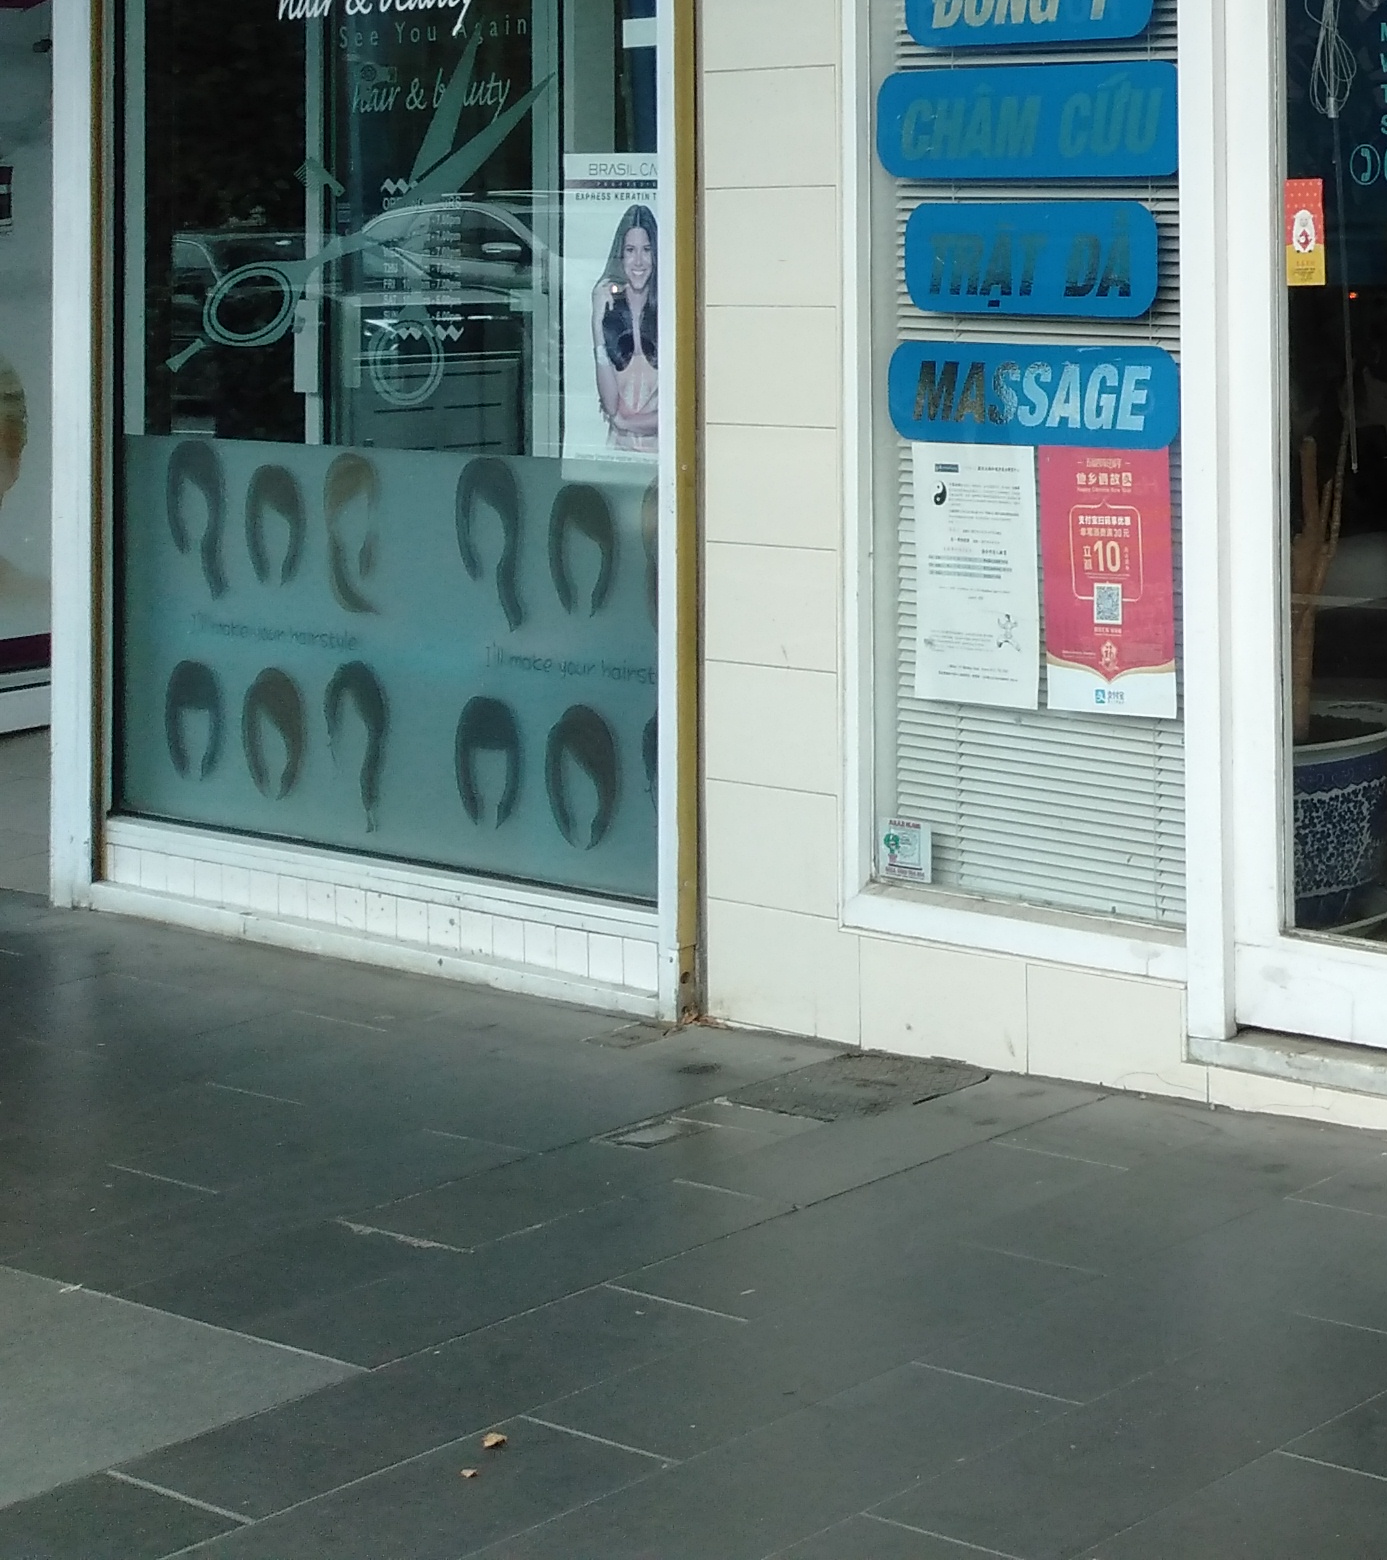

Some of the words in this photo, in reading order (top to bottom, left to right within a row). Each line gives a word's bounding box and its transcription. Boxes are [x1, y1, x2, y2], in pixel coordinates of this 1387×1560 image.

[394, 22, 437, 44] You
[432, 68, 511, 125] buty
[588, 163, 637, 176] BRASIL
[575, 192, 611, 201] EXPRESS
[614, 192, 650, 200] KERATIN
[913, 360, 1152, 432] MASSAGE
[1093, 540, 1121, 572] 10
[508, 655, 553, 673] make
[558, 659, 597, 677] your
